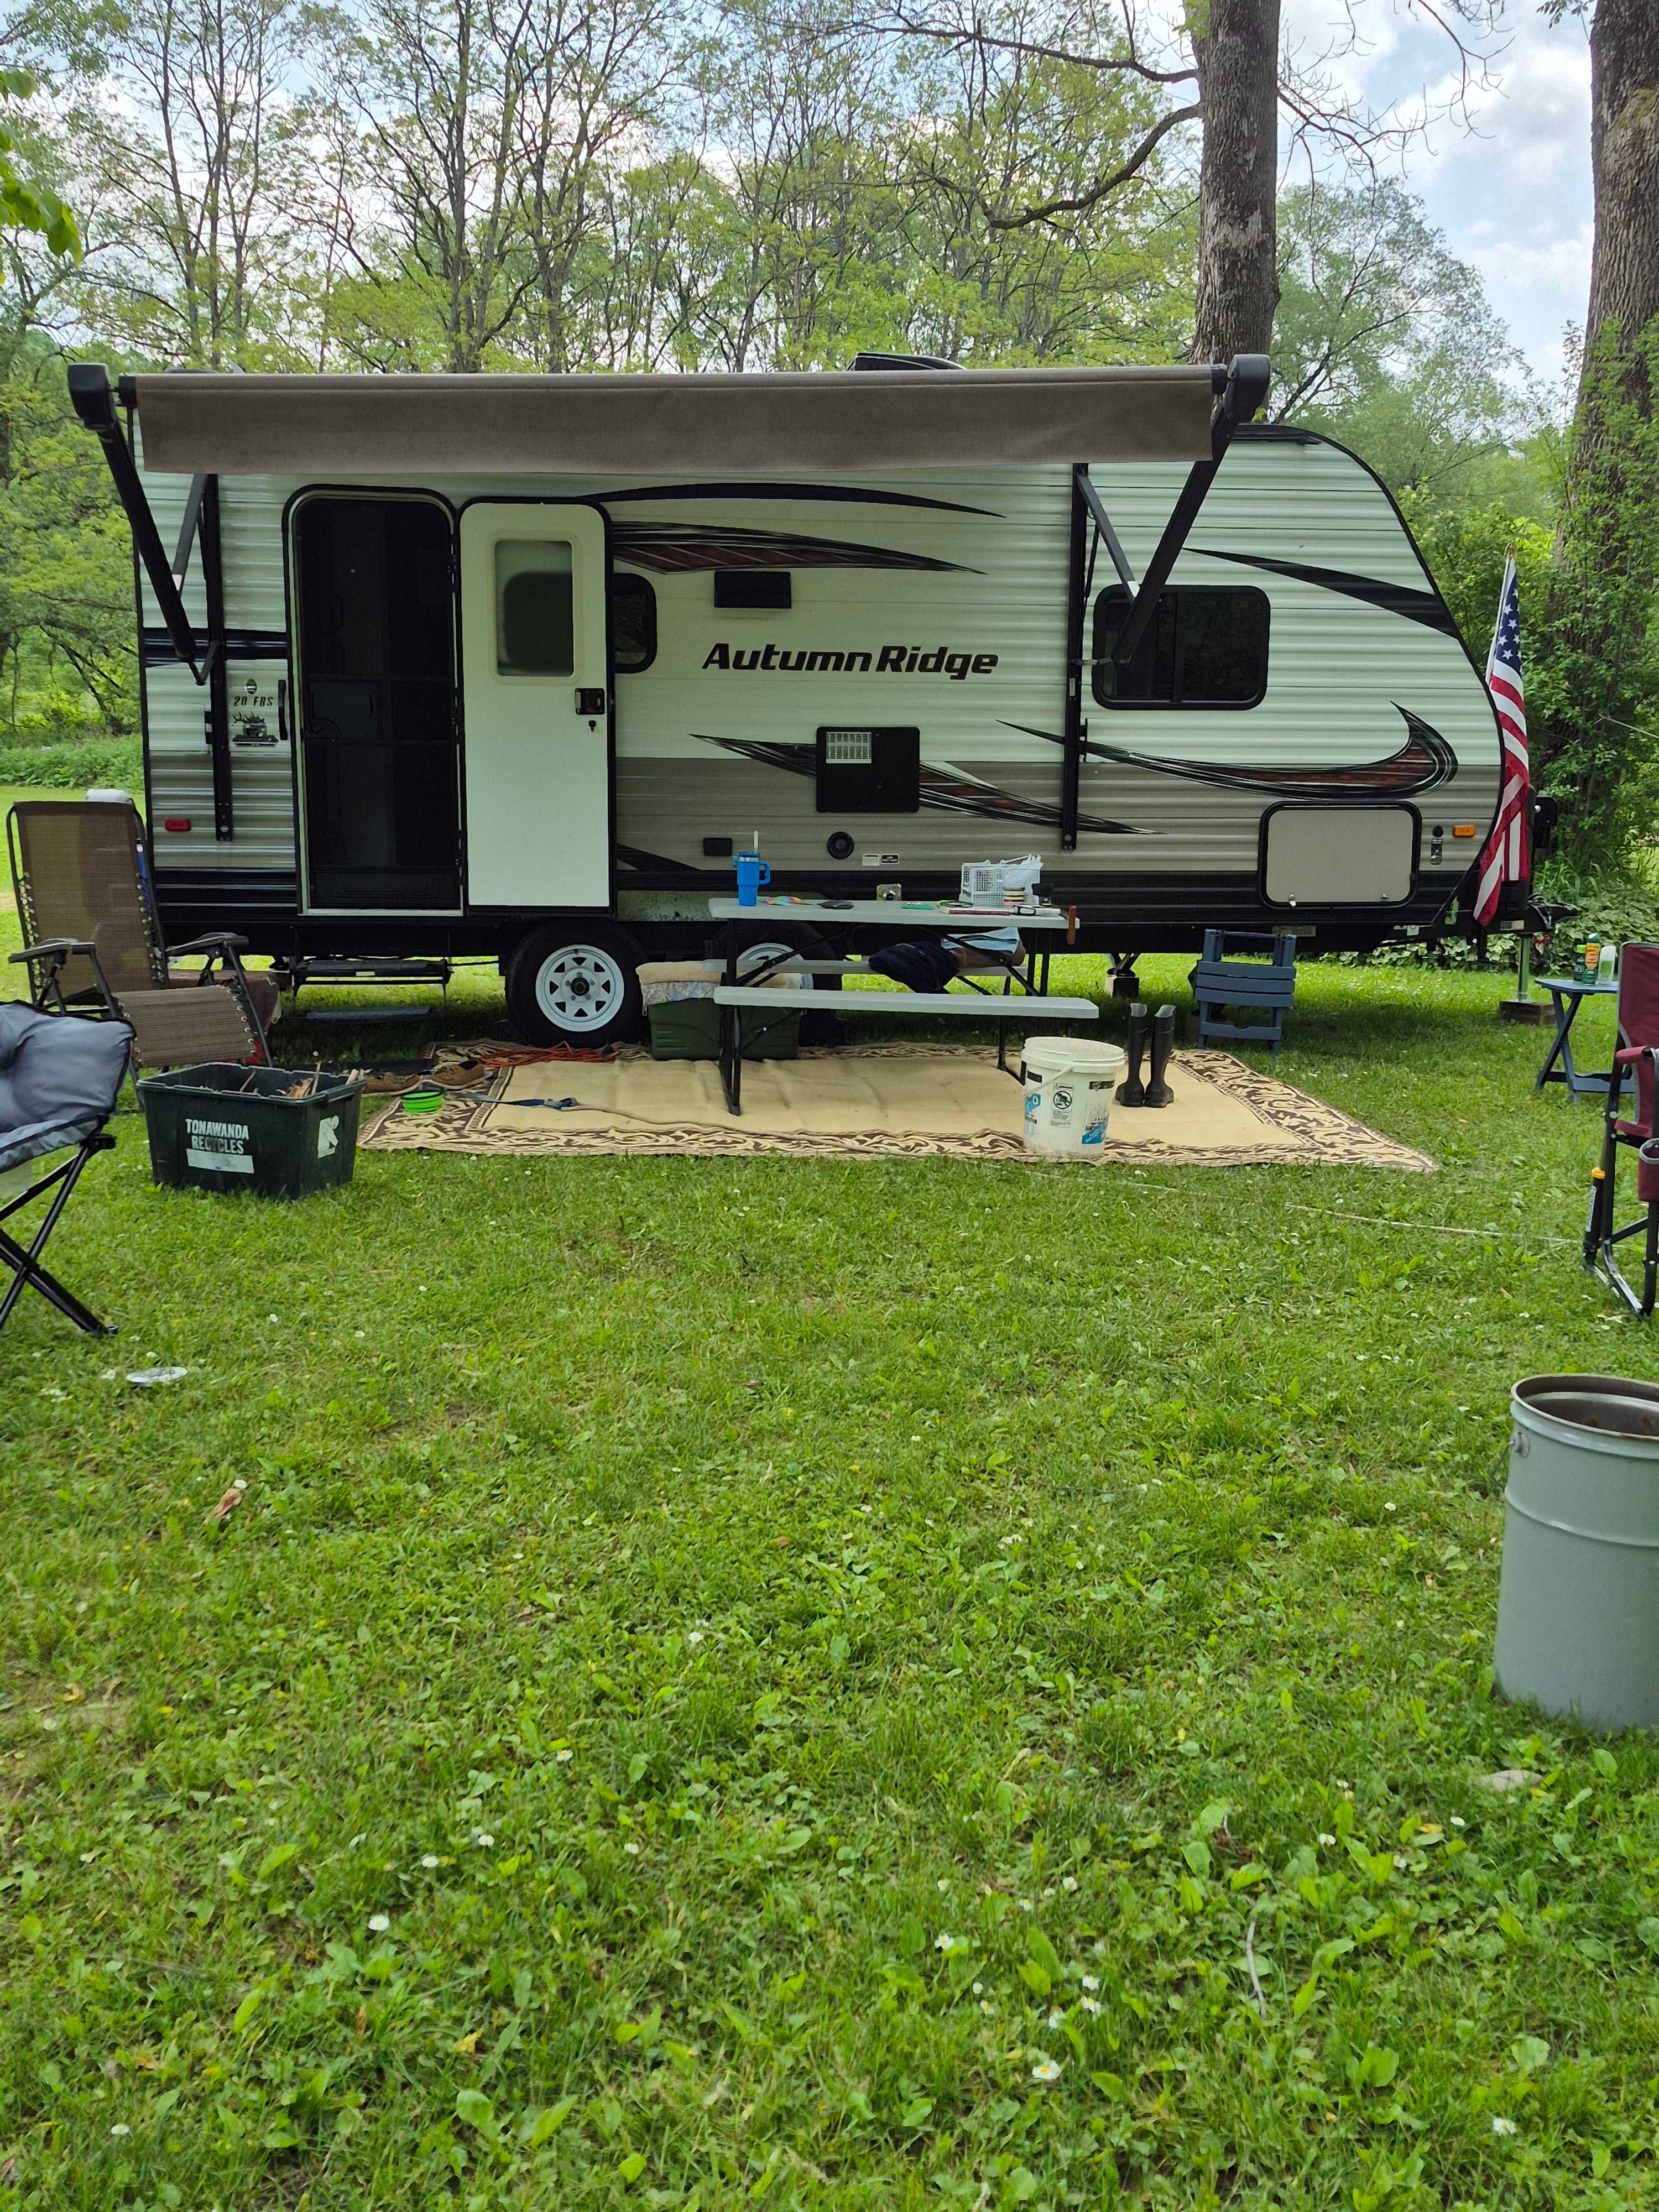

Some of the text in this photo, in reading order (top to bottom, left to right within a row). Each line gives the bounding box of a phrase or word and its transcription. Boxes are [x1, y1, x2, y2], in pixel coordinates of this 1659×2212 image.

[701, 643, 999, 680] Autumn Ridge
[233, 696, 274, 707] 20 FBS
[185, 1118, 249, 1141] TONAWANDA
[191, 1135, 244, 1155] RECYCLES
